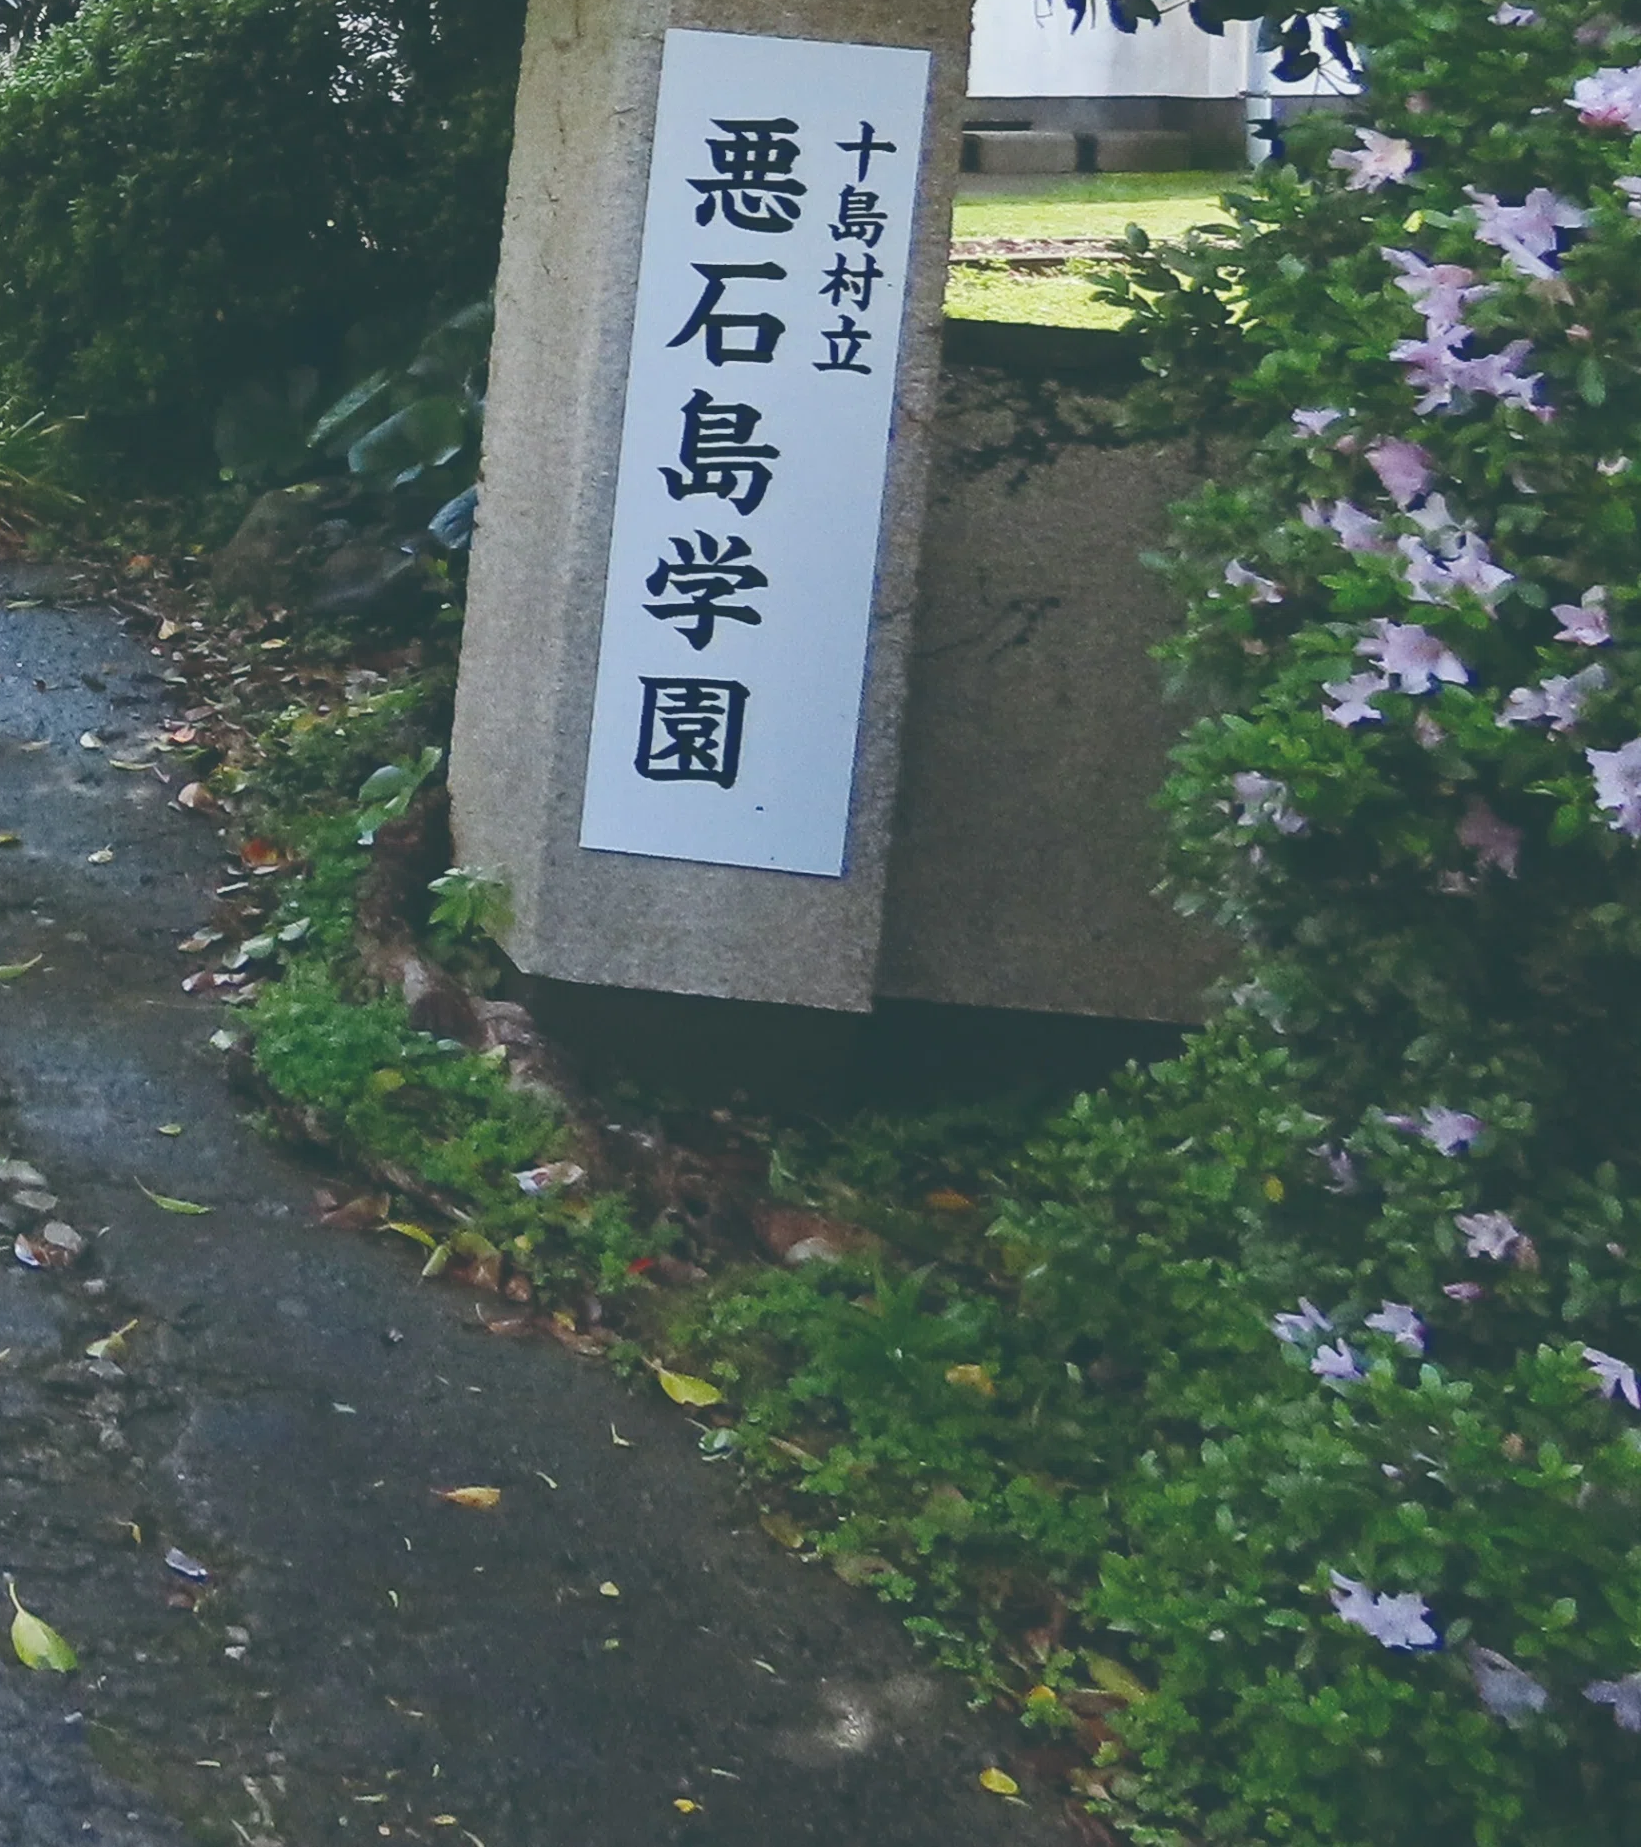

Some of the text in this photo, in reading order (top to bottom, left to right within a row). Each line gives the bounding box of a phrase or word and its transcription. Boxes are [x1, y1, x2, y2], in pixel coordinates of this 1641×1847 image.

[634, 117, 808, 790] 悪石島学園
[812, 120, 897, 375] 十島村立
